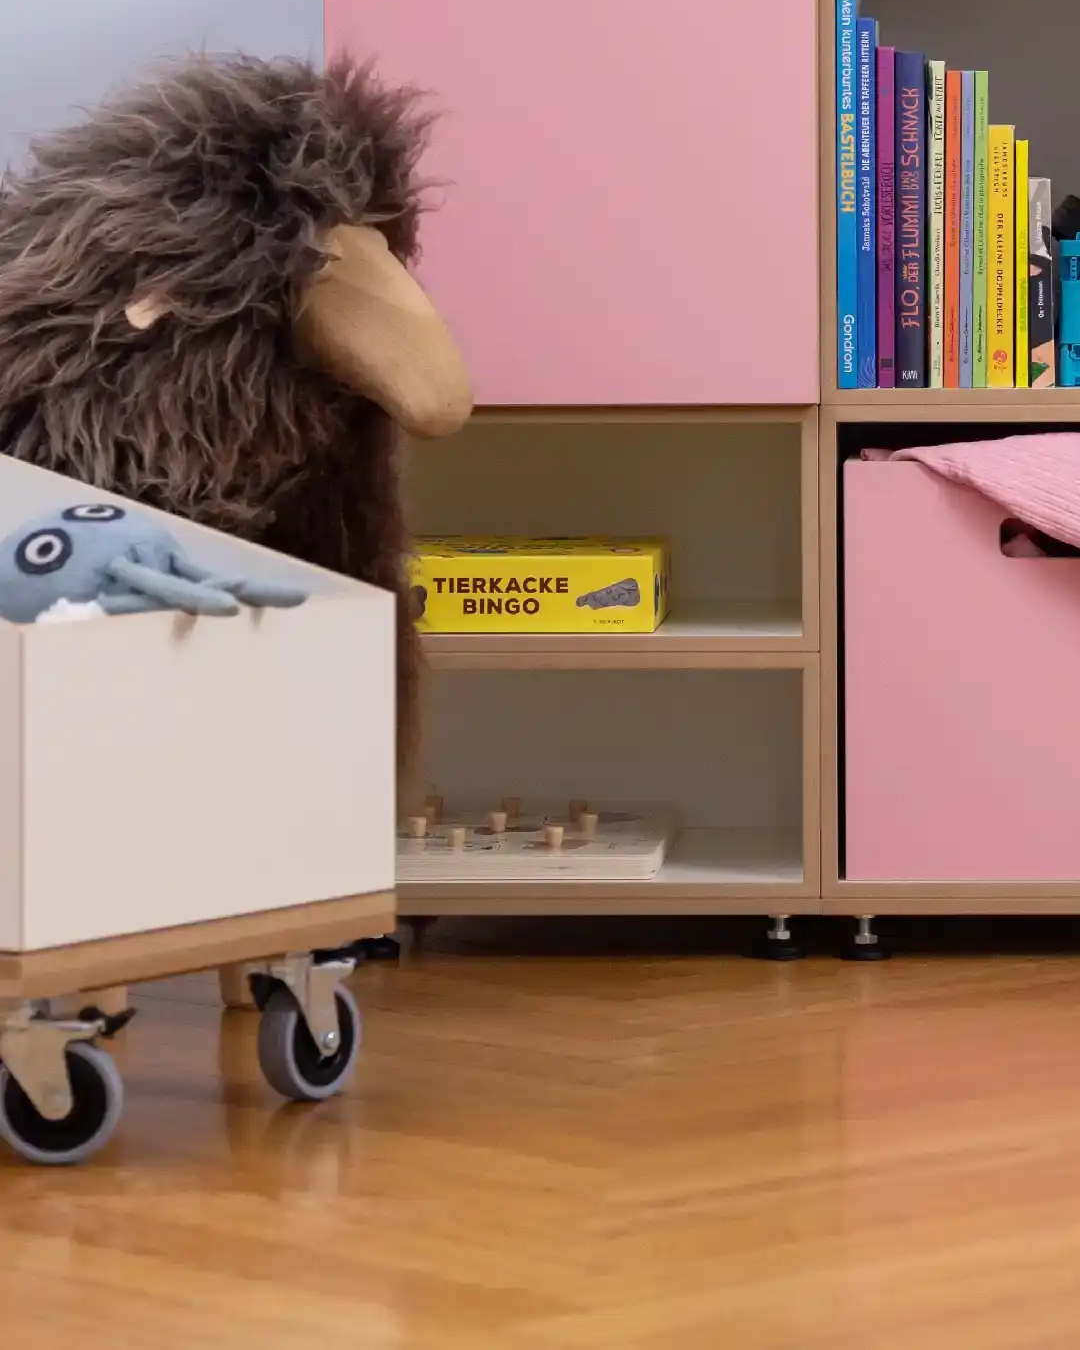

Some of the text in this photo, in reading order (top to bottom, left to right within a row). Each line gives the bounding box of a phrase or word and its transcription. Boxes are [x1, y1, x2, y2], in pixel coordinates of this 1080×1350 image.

[841, 29, 853, 110] kunterbuntes
[861, 31, 870, 171] DIE ABENTEUER DER TAPFEREN RITTERIN
[901, 87, 920, 168] SCHNACK
[840, 113, 854, 213] BASTELBUCH
[900, 171, 910, 190] UND
[900, 195, 920, 260] FLUMMI
[908, 262, 919, 283] DER
[996, 213, 1004, 335] DER KLEINE DOPPELDECKER
[900, 286, 920, 329] FLO,
[843, 314, 854, 373] Gondrom
[433, 577, 569, 594] TIERKACKE
[462, 597, 541, 615] BINGO
